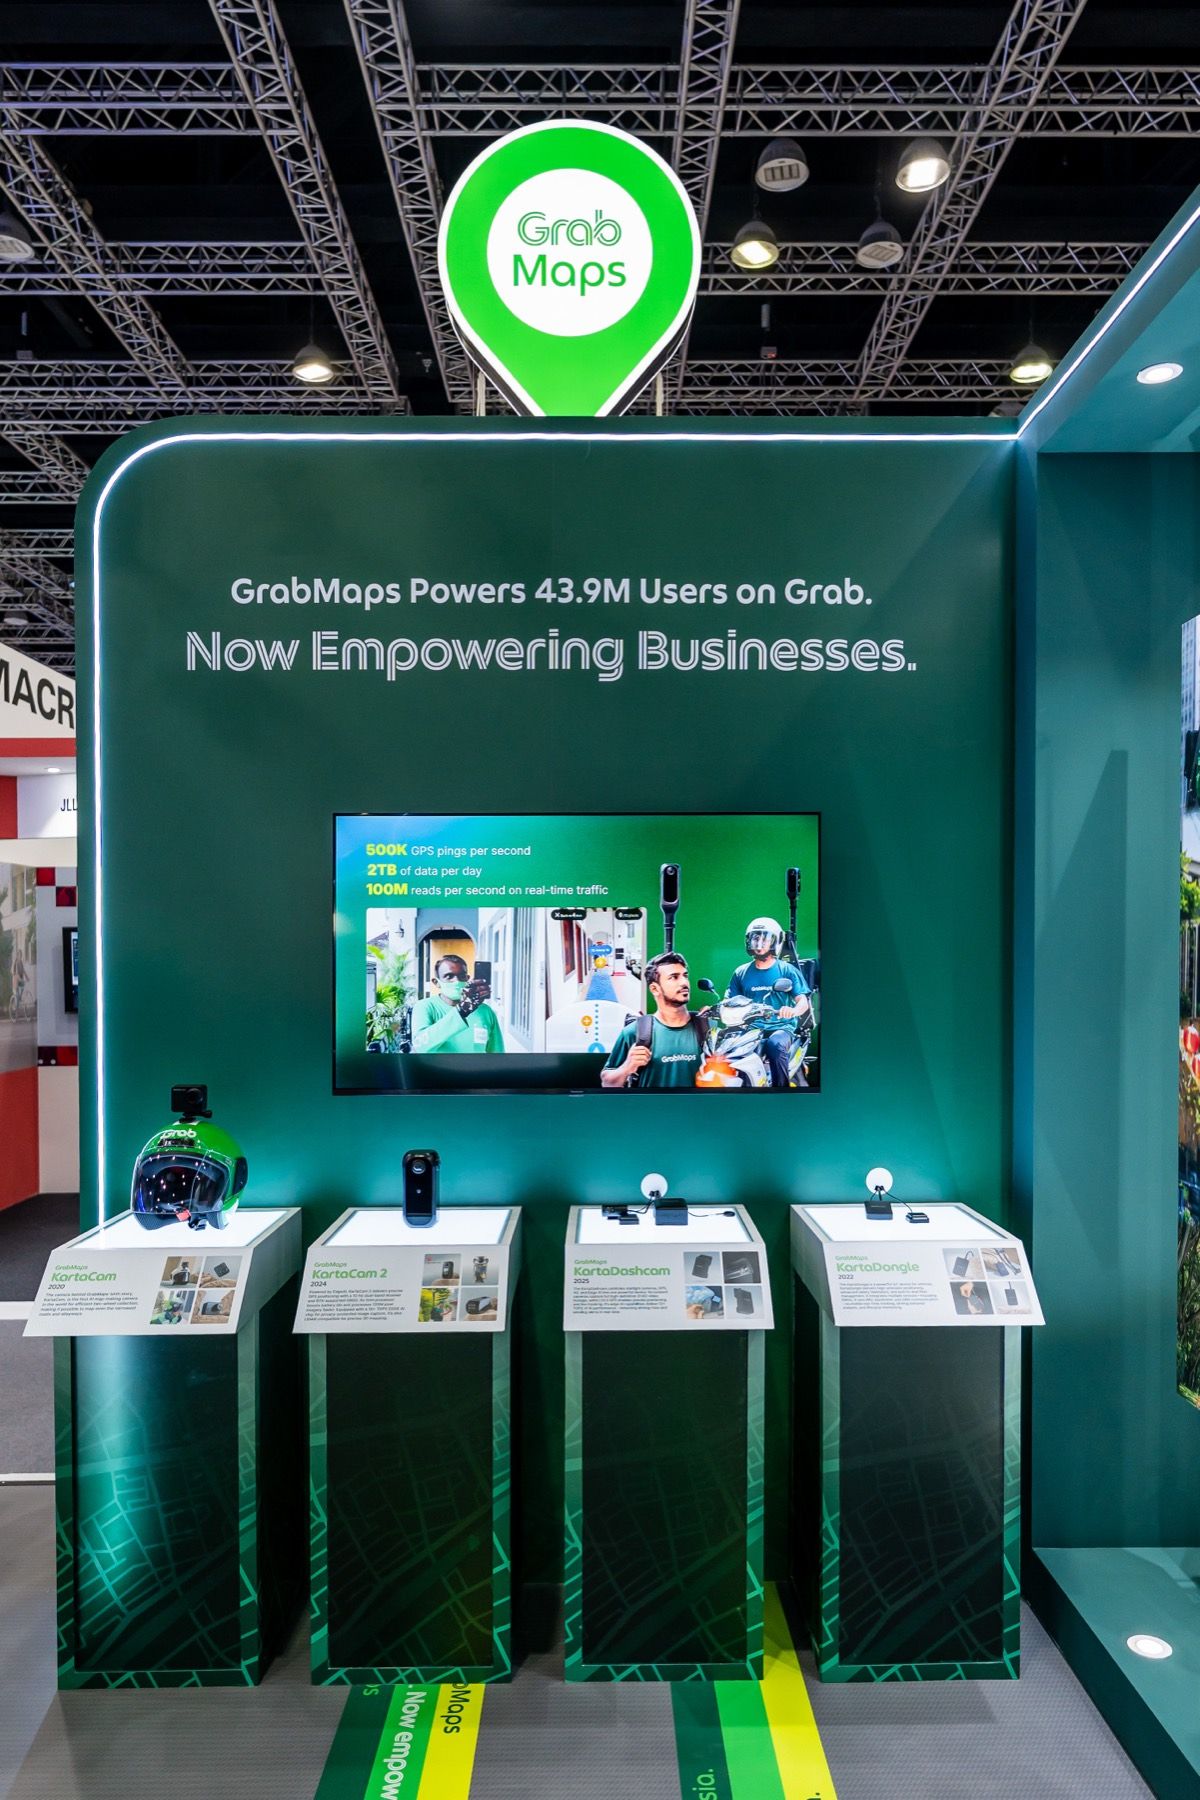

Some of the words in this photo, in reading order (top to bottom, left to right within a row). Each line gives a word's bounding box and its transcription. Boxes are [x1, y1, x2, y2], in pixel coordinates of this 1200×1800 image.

[517, 209, 622, 246] Grab
[513, 254, 627, 297] Maps
[231, 576, 401, 611] GrabMaps
[411, 578, 526, 604] Powers
[535, 578, 630, 604] 43.9M
[640, 578, 728, 605] Users
[736, 583, 776, 605] on
[784, 577, 873, 605] Grab.
[186, 631, 300, 672] Now
[312, 628, 624, 682] Empowering
[638, 629, 917, 672] Businesses.
[366, 844, 408, 856] 500K
[411, 846, 434, 856] GPS
[437, 846, 467, 858] pings
[470, 847, 488, 858] per
[491, 846, 531, 857] second
[367, 864, 397, 876] 2TB
[400, 866, 412, 876] of
[414, 866, 438, 876] data
[441, 867, 459, 878] per
[462, 866, 482, 878] day
[366, 883, 408, 896] 100M
[411, 885, 442, 895] reads
[444, 886, 463, 897] per
[466, 884, 506, 895] second
[508, 887, 522, 895] on
[525, 884, 573, 895] real-time
[576, 884, 609, 895] traffic
[661, 1054, 697, 1064] GrabMaps
[312, 1269, 378, 1279] KartaCam
[380, 1268, 388, 1279] 2
[573, 1266, 671, 1276] KartaDashcam
[836, 1262, 920, 1274] KartaDongle
[51, 1271, 117, 1282] KartaCam
[398, 1691, 427, 1729] Now
